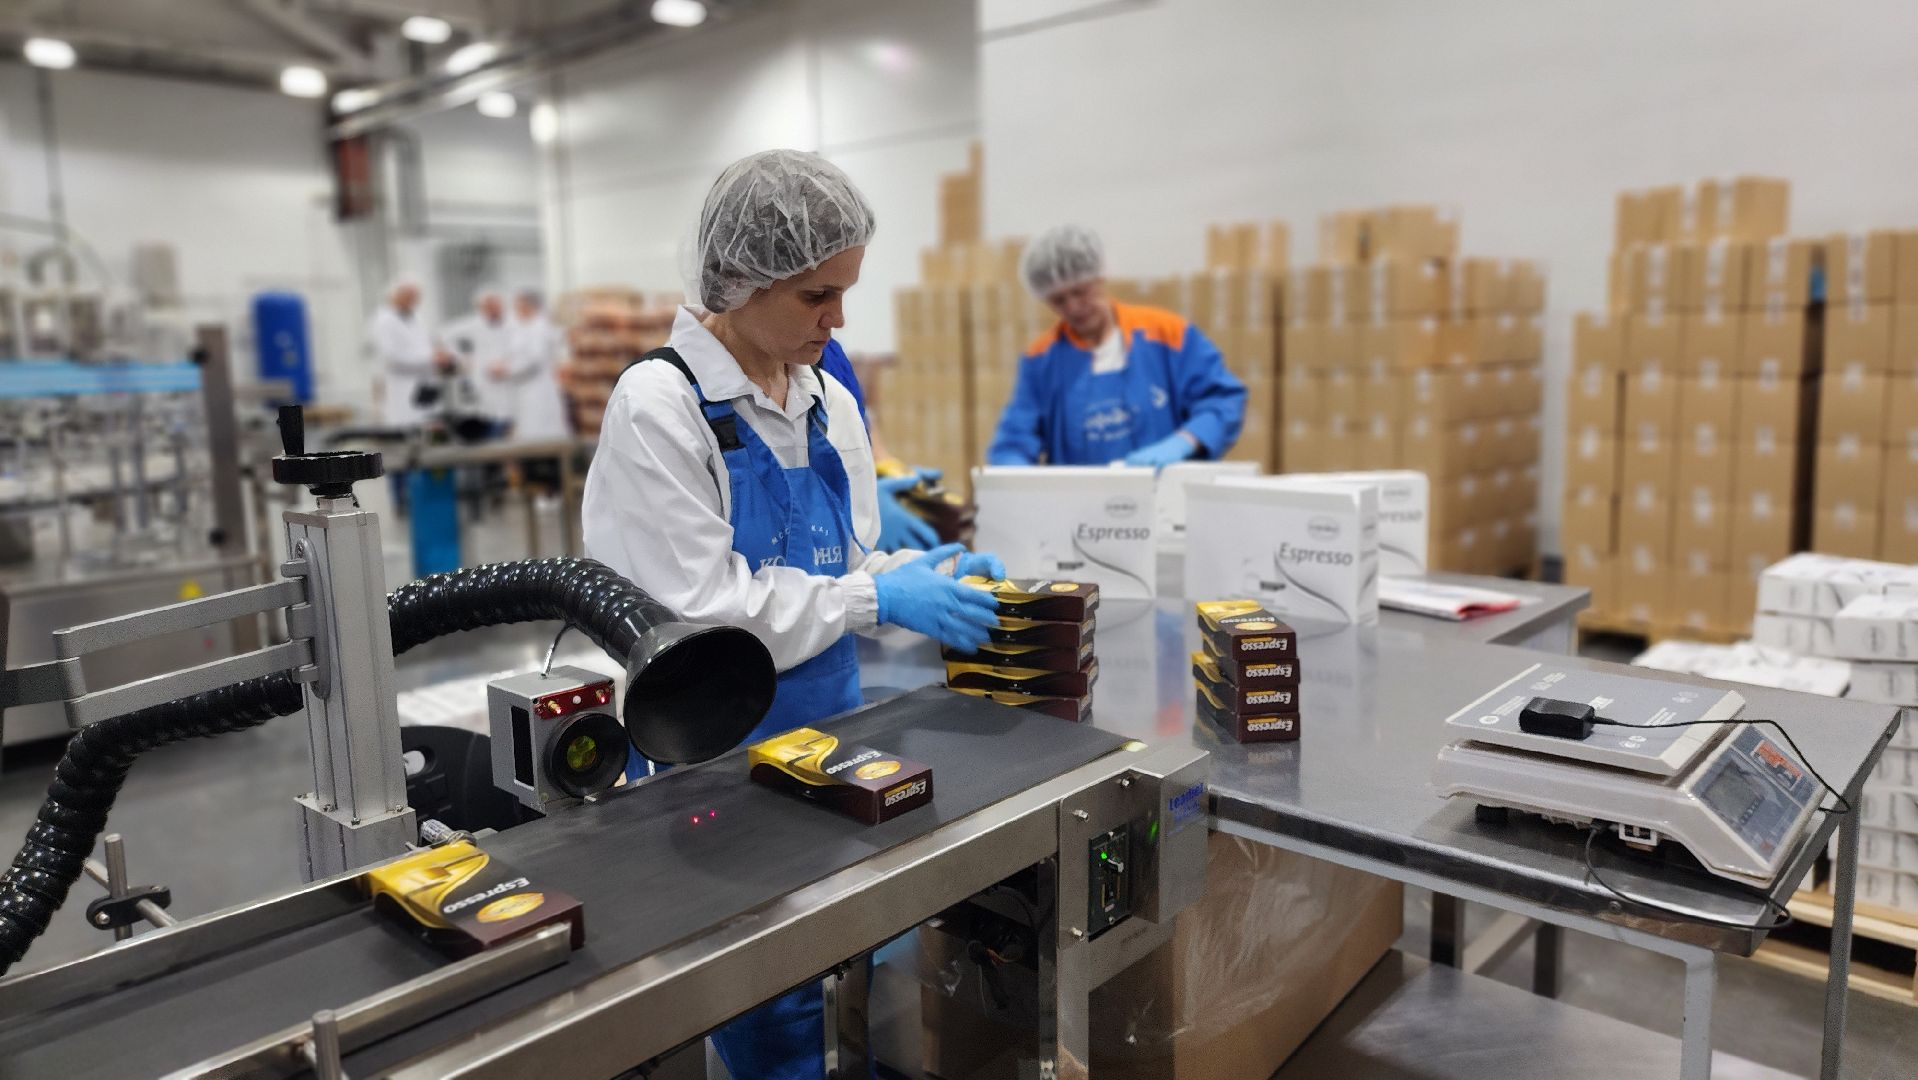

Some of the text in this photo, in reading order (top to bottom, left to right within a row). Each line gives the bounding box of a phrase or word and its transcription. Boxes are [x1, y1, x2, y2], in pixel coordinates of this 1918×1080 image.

[1076, 522, 1151, 544] Espresso
[1278, 541, 1354, 566] Espresso
[1241, 638, 1288, 651] Espresso
[1245, 664, 1293, 678] Espresso
[1245, 691, 1292, 705] Espresso
[1247, 718, 1294, 732] Espresso
[826, 750, 882, 776] Espresso
[884, 779, 926, 807] Espresso
[443, 876, 531, 915] Espresso
